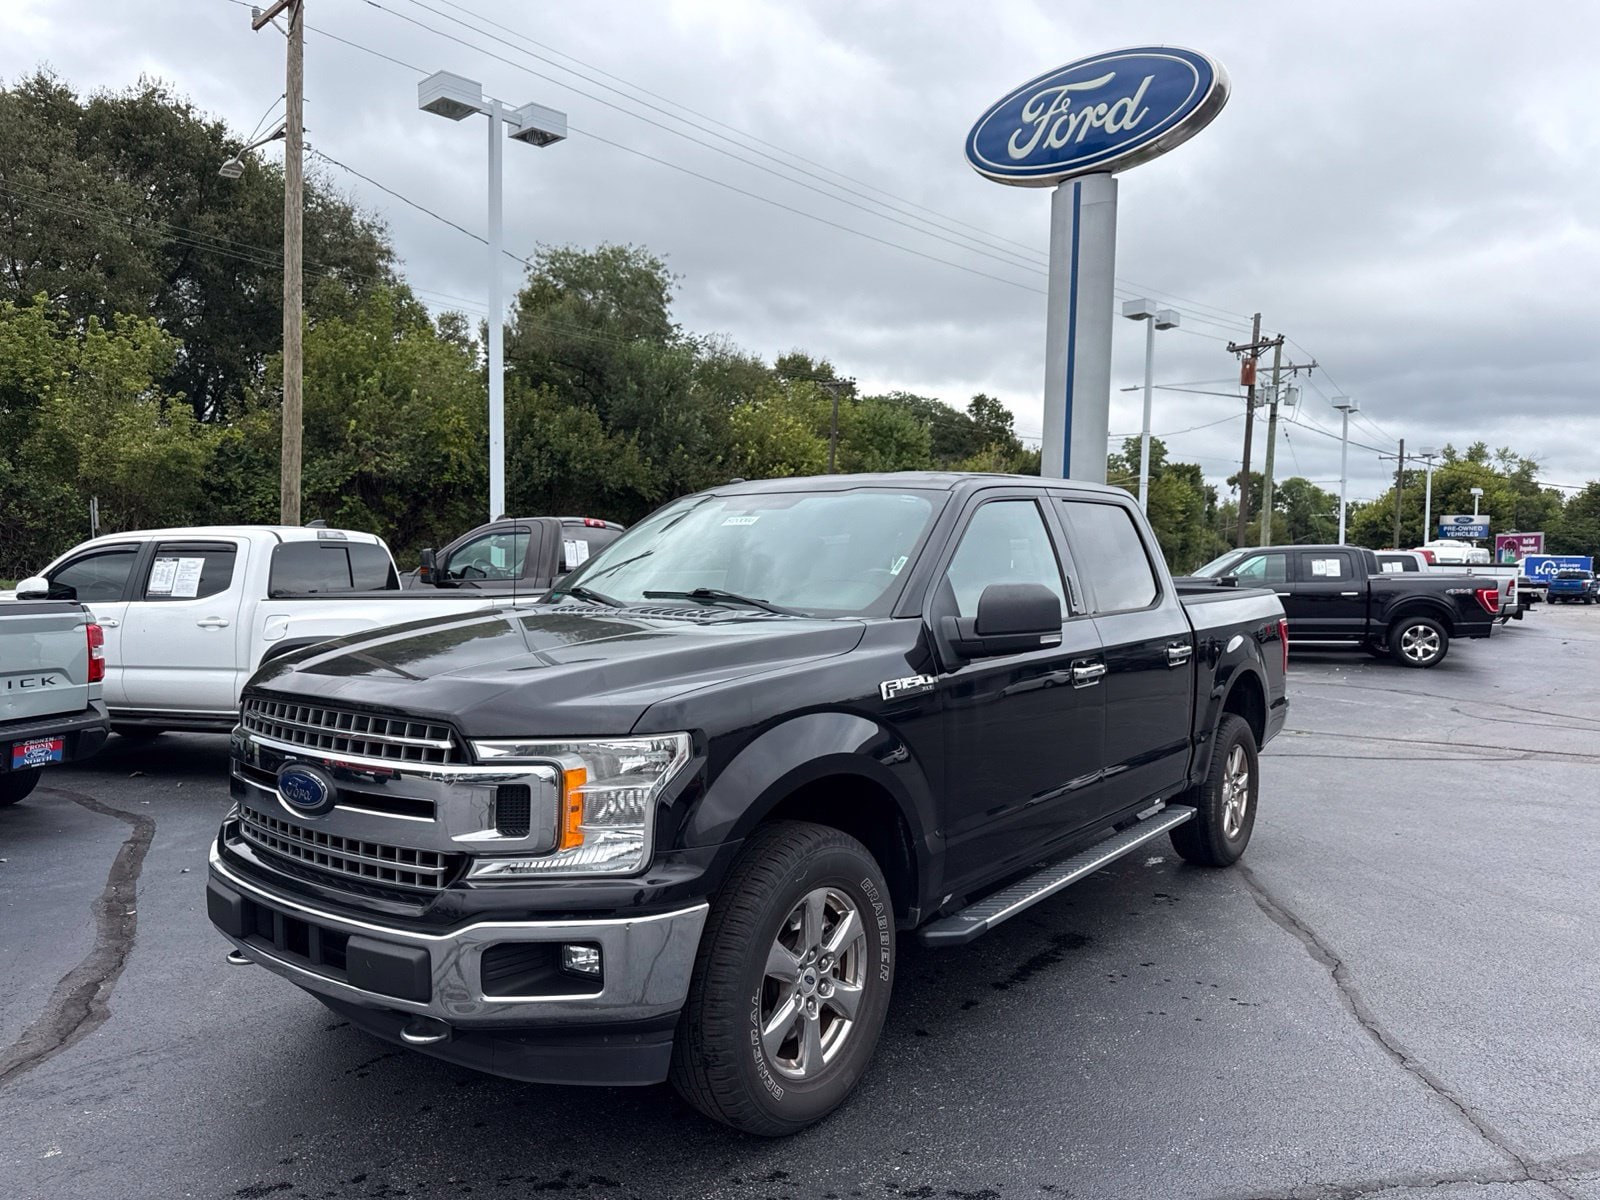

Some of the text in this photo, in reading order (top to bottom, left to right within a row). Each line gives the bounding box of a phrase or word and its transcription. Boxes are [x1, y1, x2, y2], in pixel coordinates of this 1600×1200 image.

[1008, 71, 1155, 160] Ford
[24, 742, 54, 753] CRONIN
[24, 755, 52, 765] NORTH
[285, 775, 313, 801] Ford
[860, 878, 890, 982] GRABBER
[750, 987, 784, 1101] GENERAL
